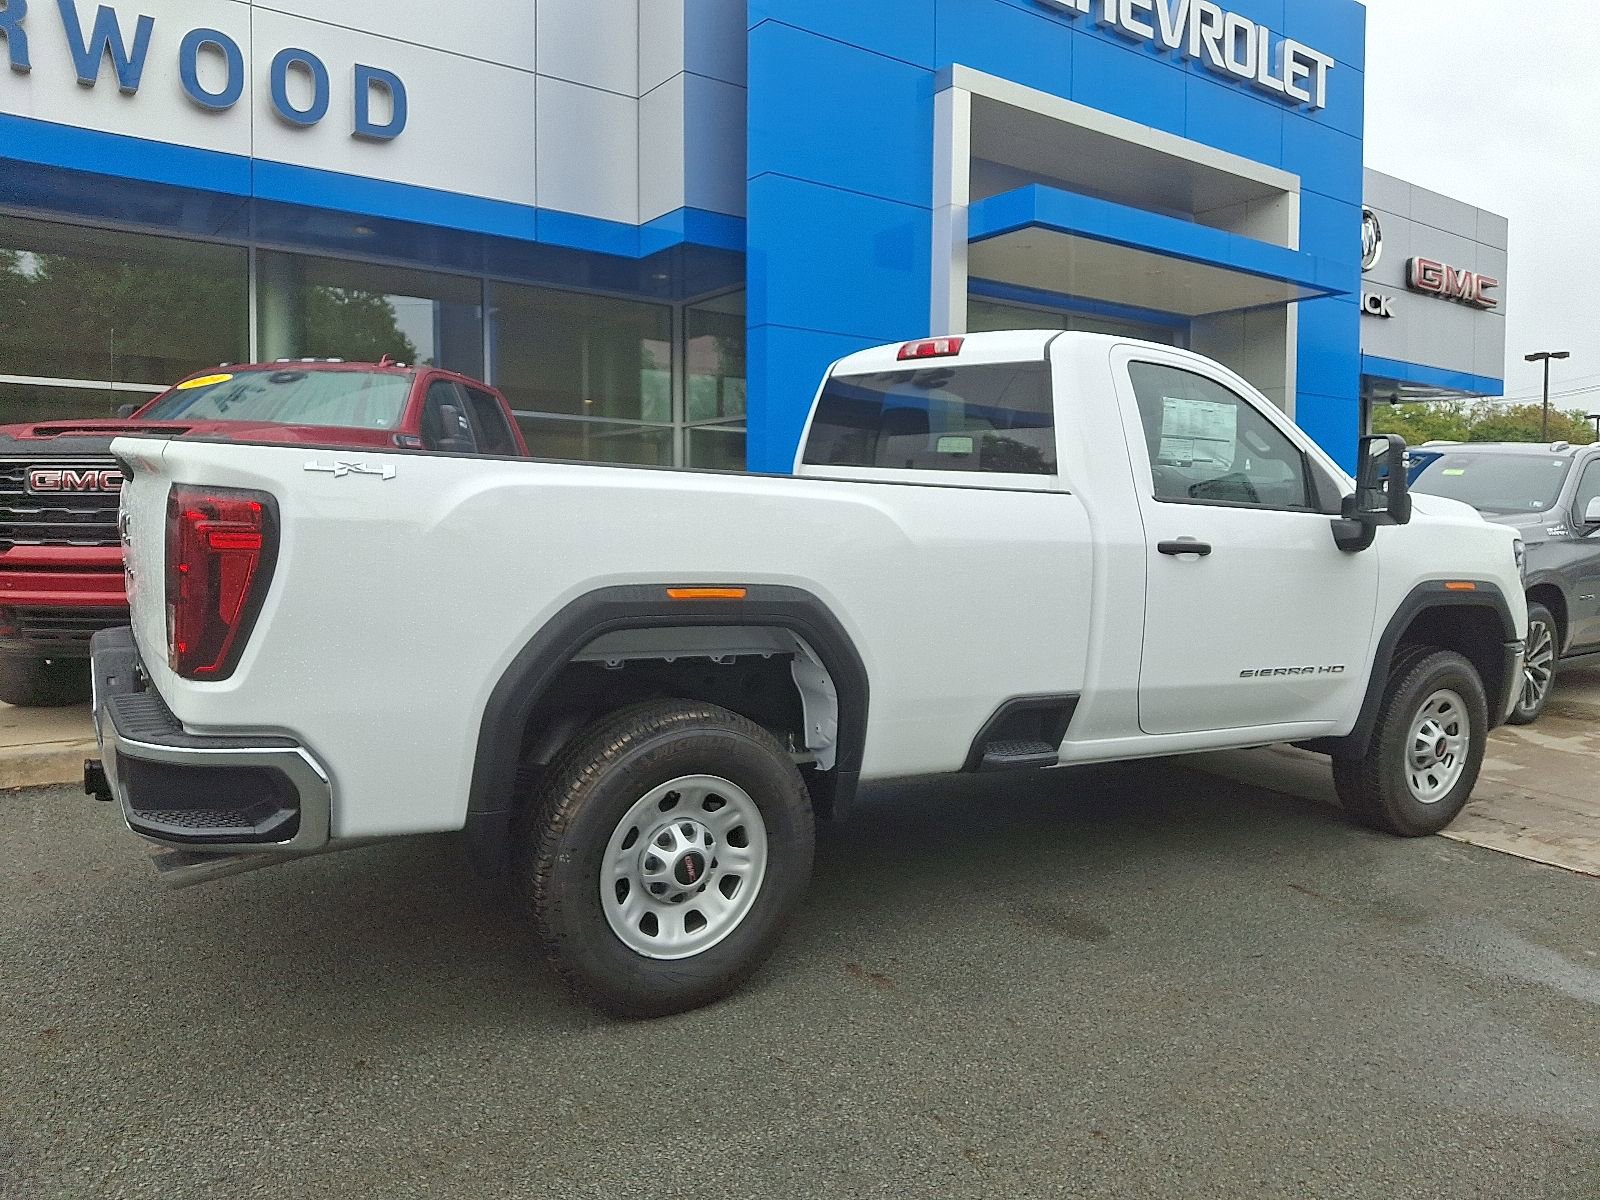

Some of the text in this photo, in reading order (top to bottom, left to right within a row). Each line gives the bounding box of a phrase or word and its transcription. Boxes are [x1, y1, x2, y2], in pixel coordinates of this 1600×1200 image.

[1408, 256, 1498, 307] GMC
[31, 471, 124, 491] GMC
[1239, 664, 1345, 678] SIERRA HD
